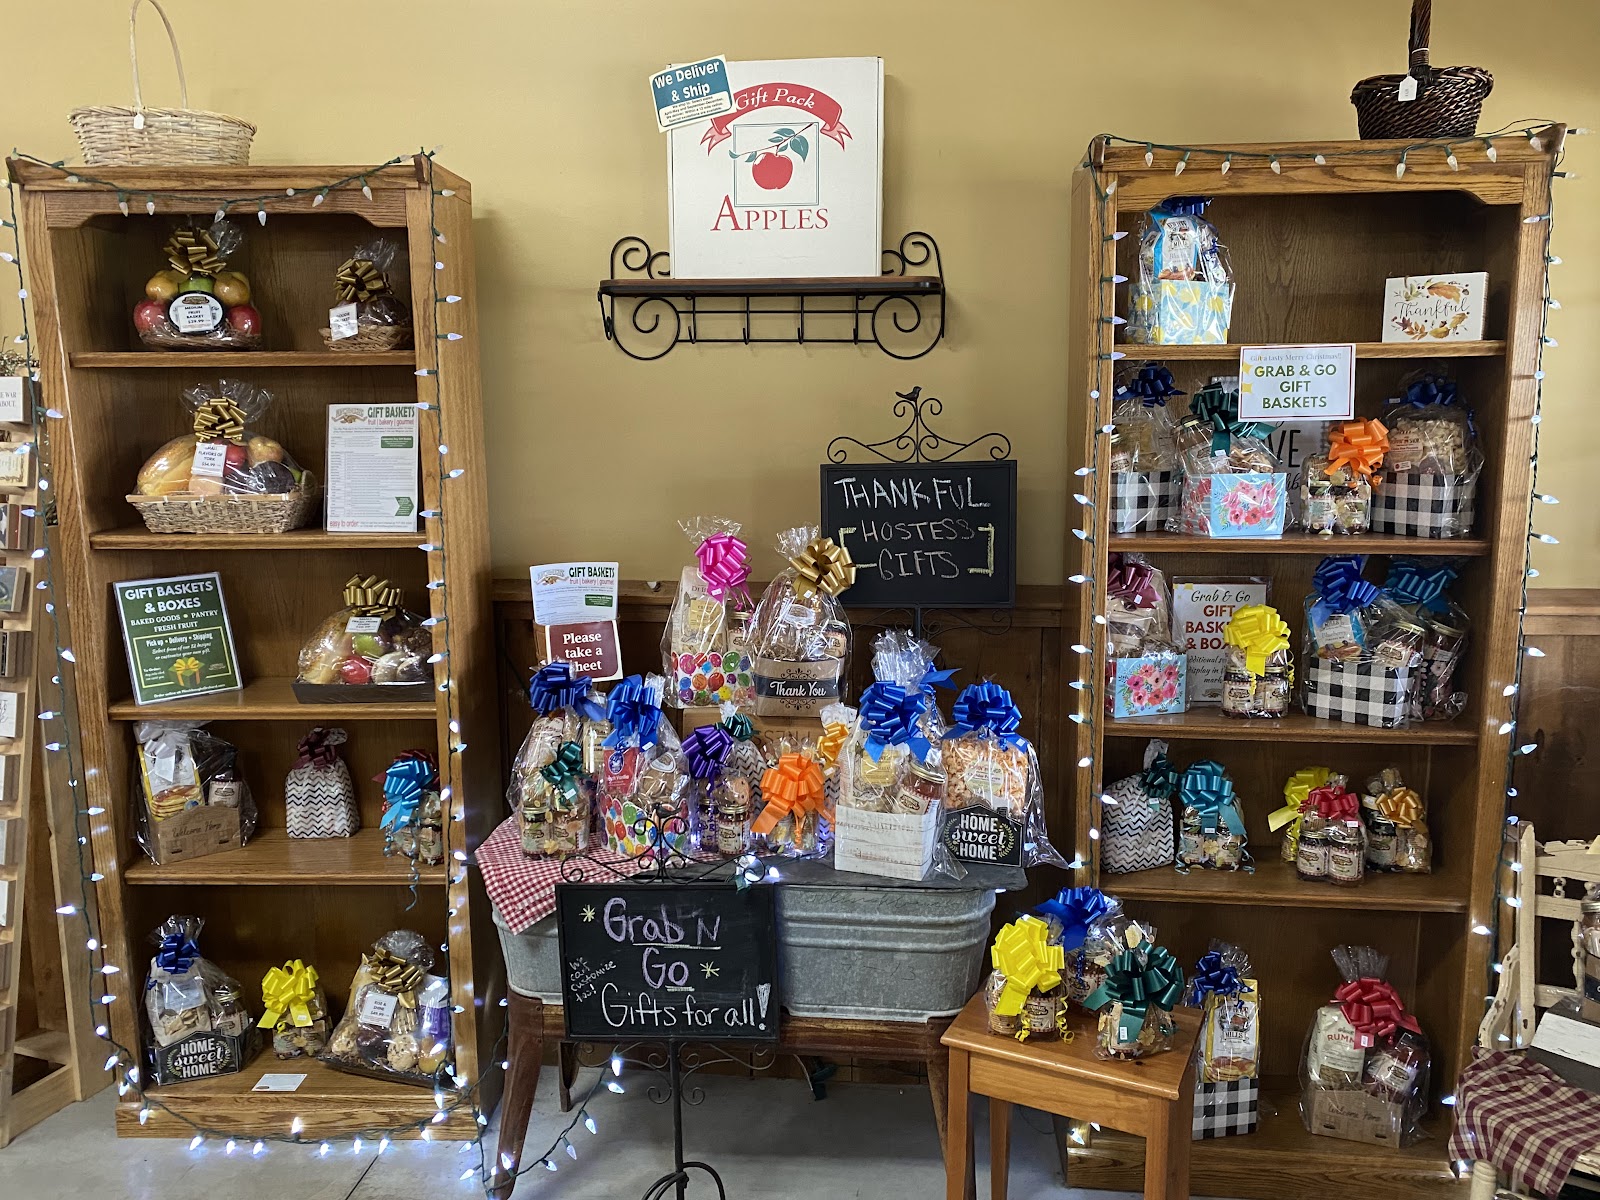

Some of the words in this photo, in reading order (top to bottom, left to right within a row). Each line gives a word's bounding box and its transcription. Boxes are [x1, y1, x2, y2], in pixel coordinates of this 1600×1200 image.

[655, 74, 673, 88] We
[676, 62, 719, 82] Deliver
[672, 90, 680, 102] &
[683, 83, 710, 98] Ship
[735, 87, 768, 110] Gift
[772, 88, 816, 109] Pack
[1395, 297, 1471, 319] Thankful
[1254, 365, 1295, 377] GRAB
[1300, 365, 1310, 376] &
[1314, 364, 1337, 376] GO
[1280, 380, 1311, 392] GIFT
[1262, 396, 1327, 409] BASKETS
[368, 407, 384, 418] GIFT
[385, 406, 414, 418] BASKETS
[834, 477, 991, 510] THANKFUL
[861, 518, 975, 542] HOSTESS
[569, 567, 586, 578] GIFT
[588, 567, 614, 578] BASKETS
[879, 548, 960, 580] GIFTS
[125, 588, 153, 600] GIFT
[156, 581, 213, 597] BASKETS
[1191, 590, 1219, 603] Grab
[1222, 590, 1232, 601] &
[1236, 590, 1250, 601] Go
[145, 603, 156, 614] &
[158, 598, 201, 612] BOXES
[1203, 605, 1235, 617] GIFT
[131, 617, 155, 626] BAKED
[156, 614, 180, 623] GOODS
[191, 610, 218, 618] PANTRY
[154, 624, 176, 632] FRESH
[1186, 622, 1229, 633] BASK
[563, 633, 602, 644] Please
[1185, 638, 1196, 649] &
[1200, 637, 1229, 649] BO
[565, 647, 592, 658] take
[596, 647, 602, 655] a
[575, 660, 602, 672] heet
[770, 680, 806, 697] Thank
[808, 681, 827, 697] You
[960, 814, 999, 832] HOME
[952, 826, 1006, 850] sweet
[958, 843, 997, 860] HOME
[604, 897, 685, 943] Grab
[697, 915, 720, 945] N
[642, 947, 689, 989] Go
[602, 982, 676, 1027] Gifts
[682, 994, 719, 1026] for
[181, 1038, 215, 1056] HOME
[174, 1046, 223, 1067] sweet
[182, 1064, 216, 1079] HOME
